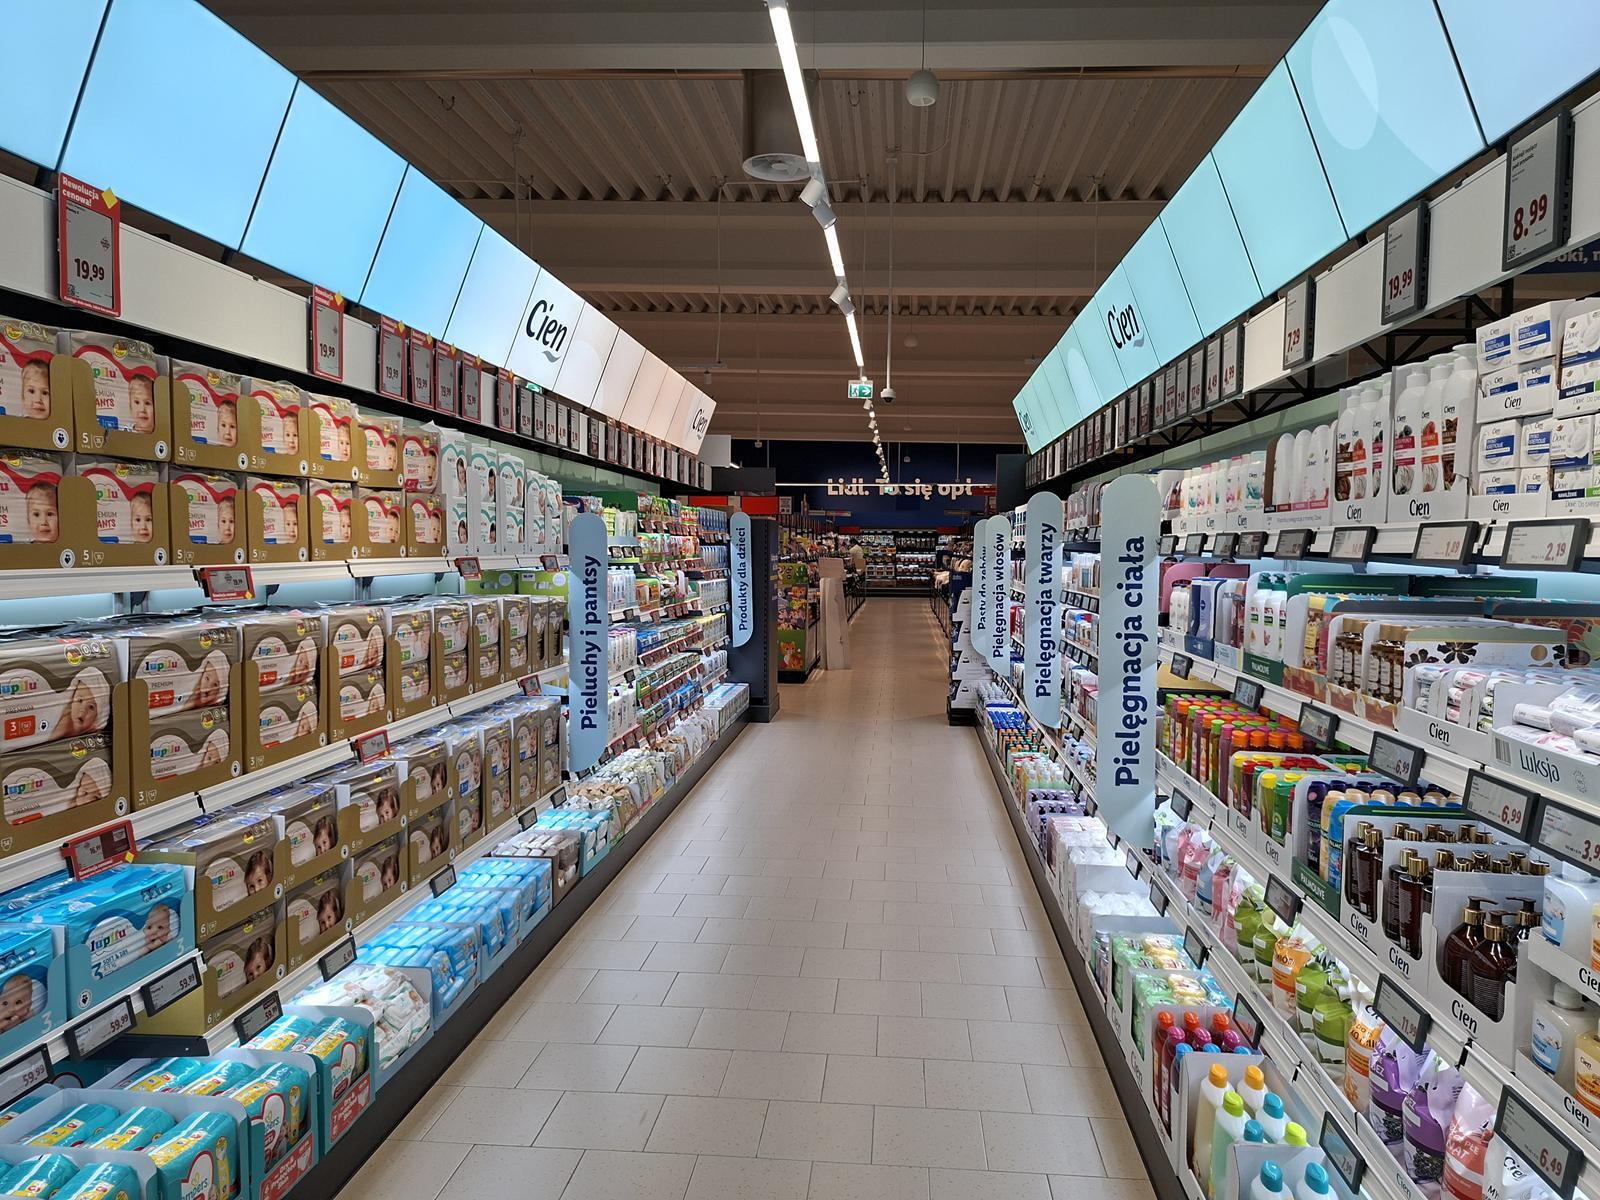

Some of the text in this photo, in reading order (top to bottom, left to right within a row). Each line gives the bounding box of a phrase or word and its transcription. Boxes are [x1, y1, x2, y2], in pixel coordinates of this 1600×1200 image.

[62, 176, 99, 200] Rewolucja
[62, 189, 92, 206] cenowa!
[1514, 194, 1547, 241] 8.99
[74, 258, 105, 282] 19.99
[1388, 268, 1412, 300] 19.99
[526, 299, 568, 352] Cien
[1108, 303, 1140, 349] Cien
[1287, 328, 1300, 352] 7.29
[320, 343, 335, 359] 19.99
[92, 366, 116, 378] pilu
[386, 366, 398, 380] 19.99
[1224, 365, 1235, 385] 4.99
[96, 390, 115, 398] EMIUM
[190, 392, 208, 404] pilu
[96, 399, 115, 407] ANTS
[1504, 397, 1522, 409] Cien
[191, 421, 205, 429] ANTS
[692, 409, 708, 435] Cien
[82, 432, 89, 443] 5
[261, 430, 274, 439] ANTS
[179, 447, 184, 456] 5
[252, 456, 256, 464] 5
[96, 489, 118, 500] pilu
[188, 493, 208, 502] pilu
[828, 478, 869, 496] Lidl.
[905, 478, 932, 500] się
[938, 478, 973, 500] opł
[1347, 504, 1362, 520] Cien
[1409, 500, 1430, 516] Cien
[1492, 500, 1509, 511] Cien
[97, 518, 116, 528] ANTS
[189, 519, 205, 528] ANTS
[83, 550, 90, 560] 5
[177, 550, 183, 559] 5
[252, 549, 258, 558] 5
[1544, 542, 1567, 561] 2.19
[736, 527, 748, 631] Produkty dla dzieci
[992, 533, 1006, 658] Pielęgnacja włosów
[1035, 522, 1058, 698] Pielęgnacja twarzy
[580, 555, 602, 730] Pieluchy i pantsy
[146, 661, 178, 671] lupilu
[1115, 536, 1148, 786] Pielęgnacja ciała
[10, 722, 17, 732] 3
[1429, 722, 1450, 743] Cien
[151, 745, 181, 757] lupilu
[1396, 760, 1410, 775] 6.99
[1519, 749, 1560, 783] Luksja
[4, 780, 43, 796] lupilu
[138, 791, 144, 801] 3
[1501, 805, 1522, 824] 6.99
[1236, 816, 1247, 836] Cien
[1266, 841, 1279, 862] Cien
[1581, 840, 1600, 862] 3.9
[210, 870, 234, 886] upilu
[1300, 873, 1325, 900] PALMOLIVE
[200, 924, 206, 933] 6
[1351, 913, 1368, 938] Cien
[91, 929, 126, 952] lupilu
[177, 937, 184, 956] 3
[103, 955, 114, 966] SOFT
[120, 949, 128, 958] DRY
[1389, 948, 1410, 975] Cien
[91, 962, 103, 980] 3
[179, 973, 195, 991] 59.99
[207, 1014, 212, 1023] 6
[265, 1005, 278, 1019] 59.99
[1451, 1000, 1478, 1033] Cien
[110, 1014, 129, 1032] 59.99
[1536, 1019, 1545, 1029] Cien
[1580, 1056, 1592, 1070] Cien
[23, 1065, 45, 1087] 59.99
[1564, 1097, 1589, 1128] Cien
[1540, 1148, 1562, 1176] 6.49
[181, 1178, 208, 1200] mpers
